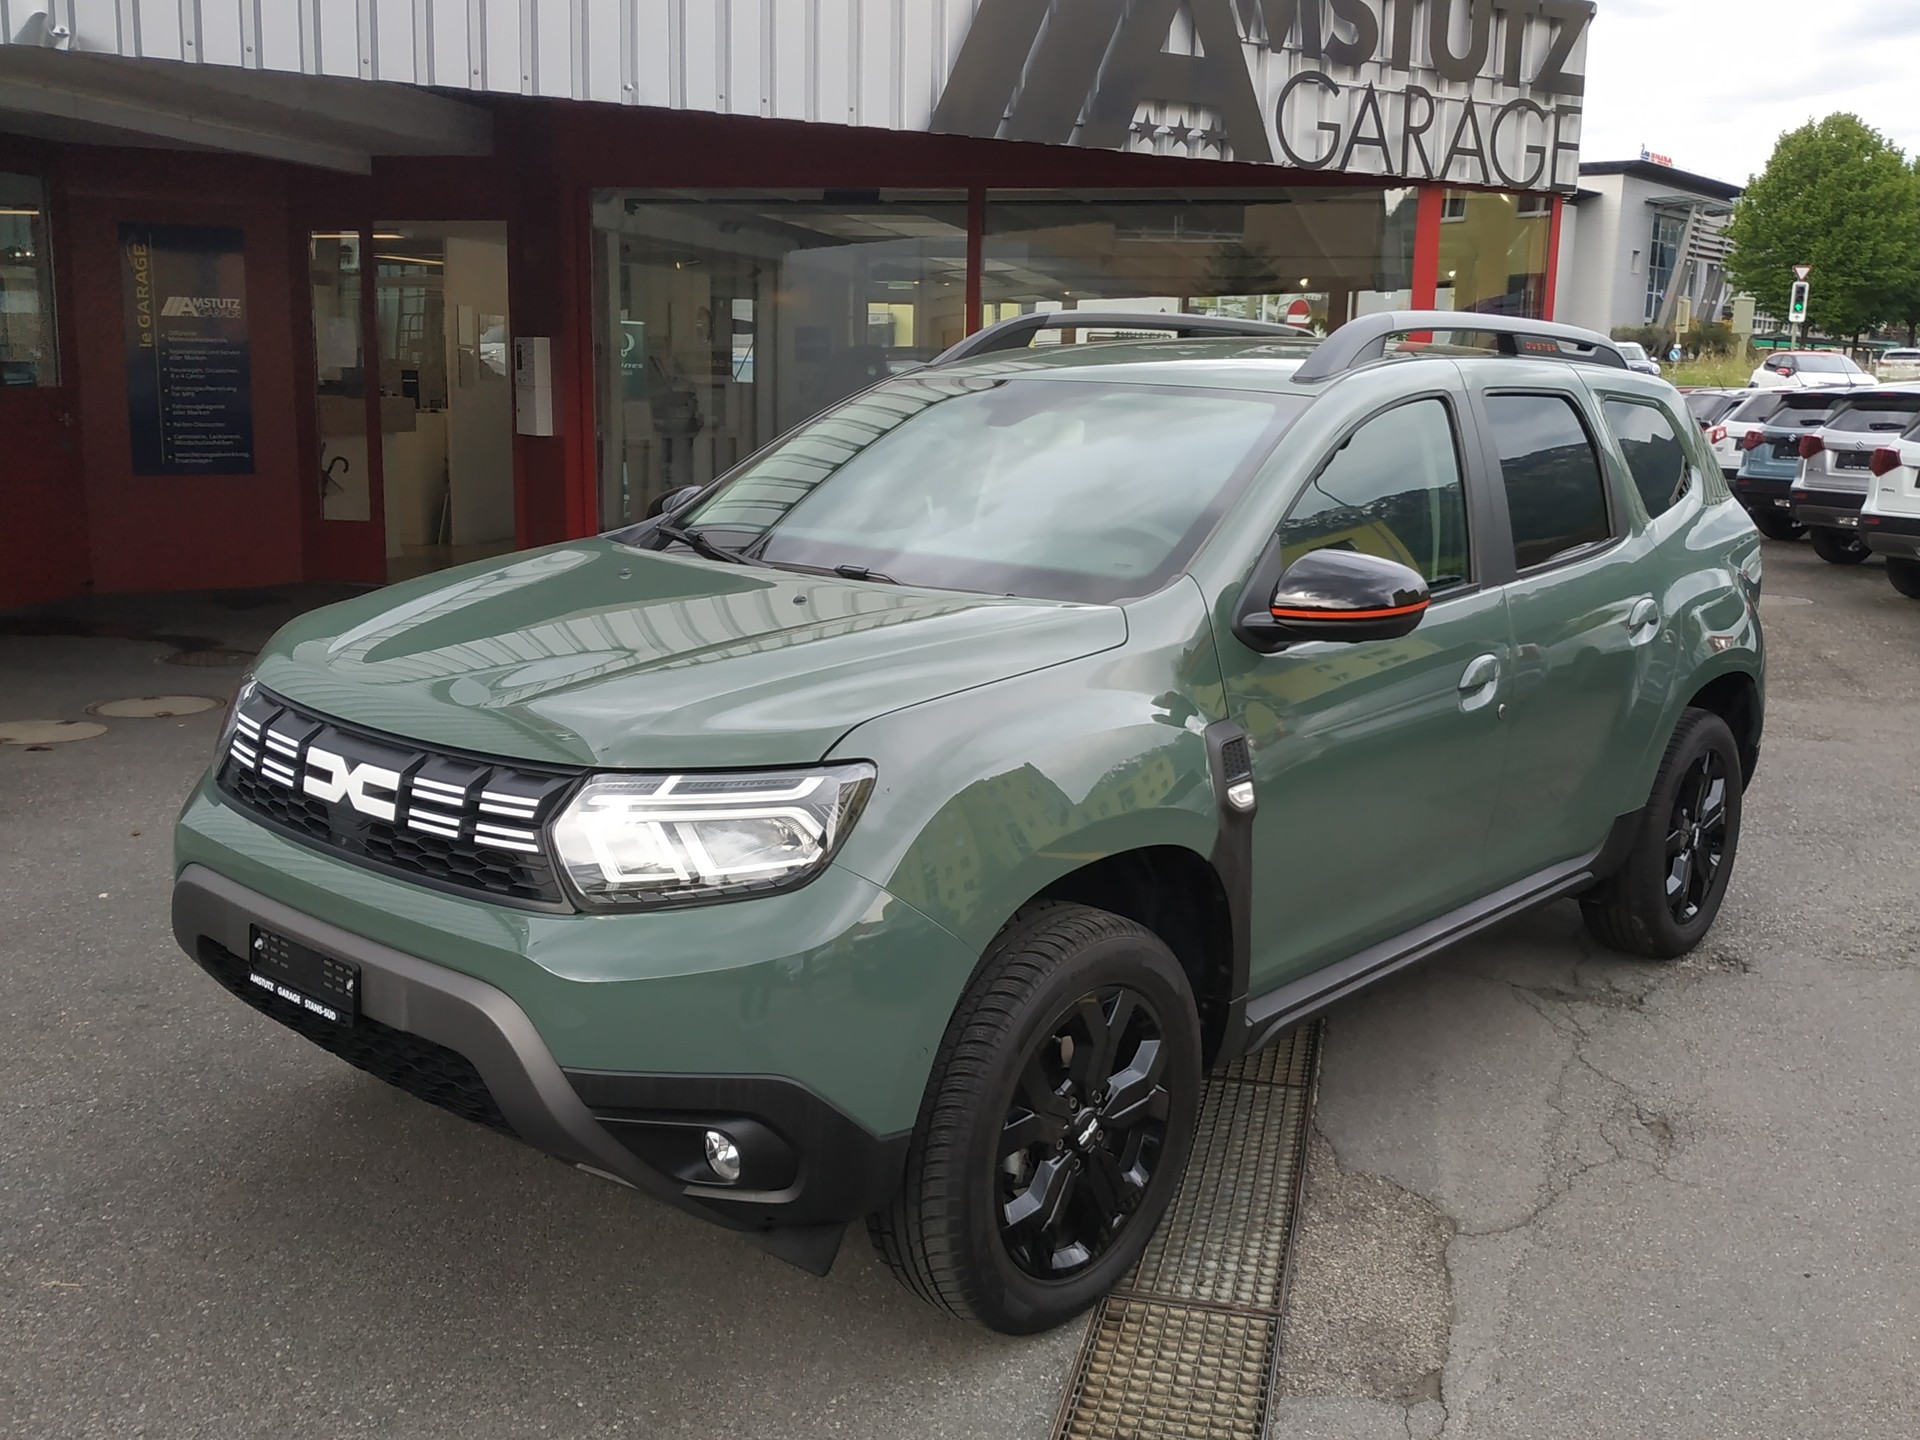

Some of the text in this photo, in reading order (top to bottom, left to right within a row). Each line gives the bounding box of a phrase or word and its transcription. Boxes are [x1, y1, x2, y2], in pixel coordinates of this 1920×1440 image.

[1276, 70, 1582, 192] GARAGE
[133, 244, 151, 328] GARAGE
[161, 296, 241, 317] AMSTUTZ
[1525, 341, 1557, 352] DUSTER
[249, 973, 274, 992] AMSTUTZ
[277, 986, 301, 1004] GARAGE
